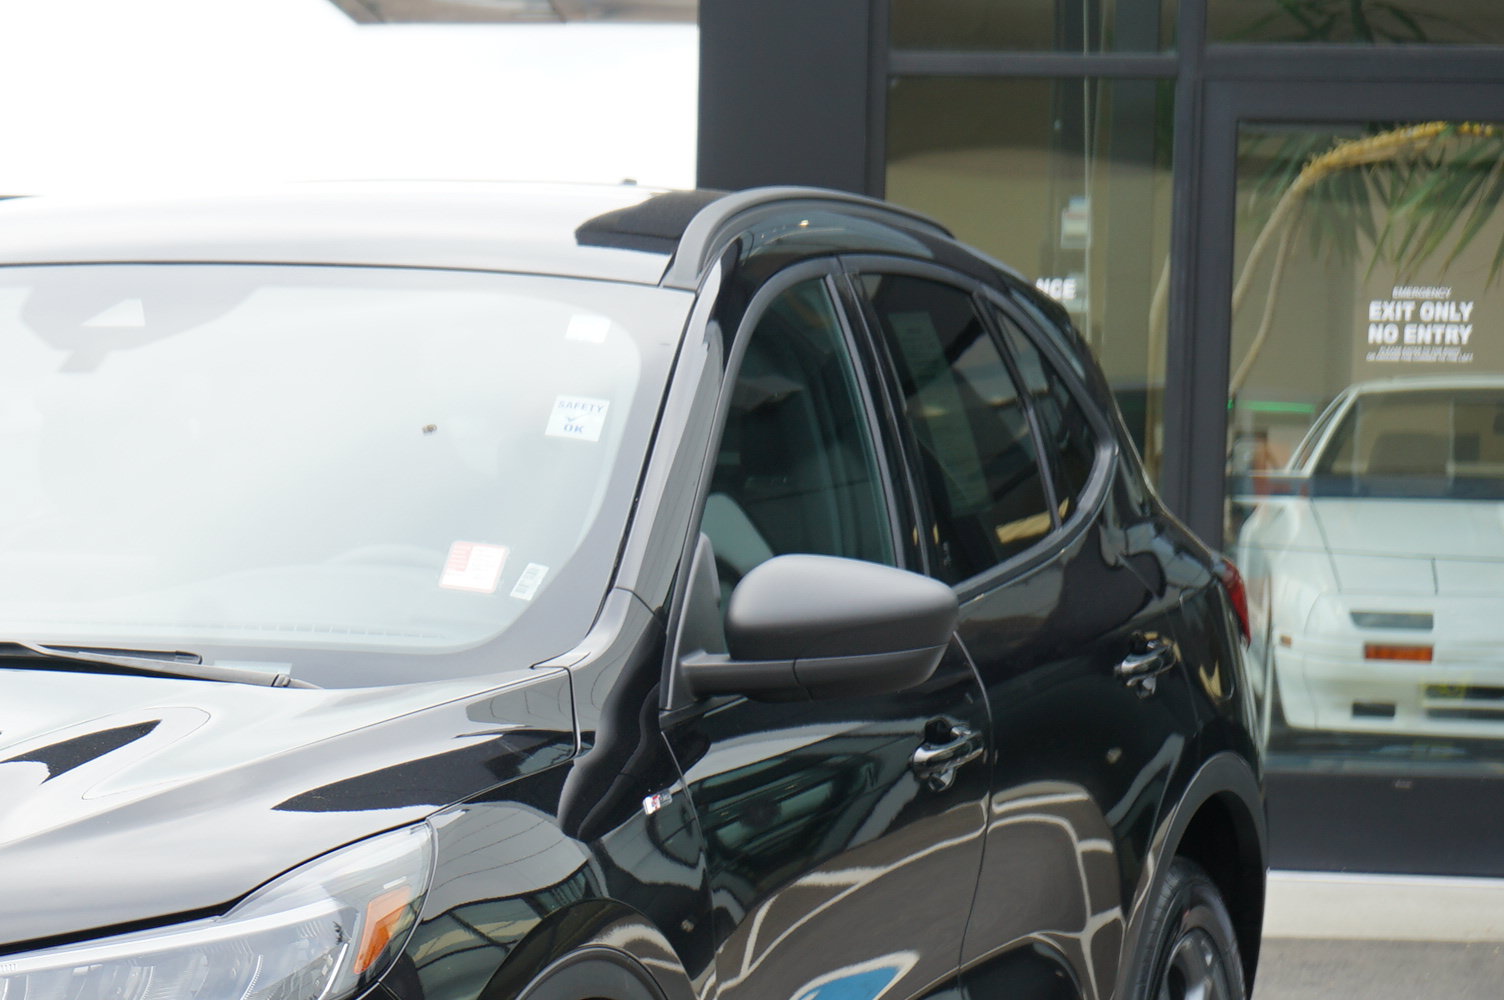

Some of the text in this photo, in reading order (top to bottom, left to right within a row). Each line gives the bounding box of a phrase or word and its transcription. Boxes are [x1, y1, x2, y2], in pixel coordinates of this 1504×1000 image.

[1392, 286, 1452, 299] EMERGENCY
[1369, 300, 1474, 322] EXIT ONLY
[1368, 323, 1473, 345] NO ENTRY
